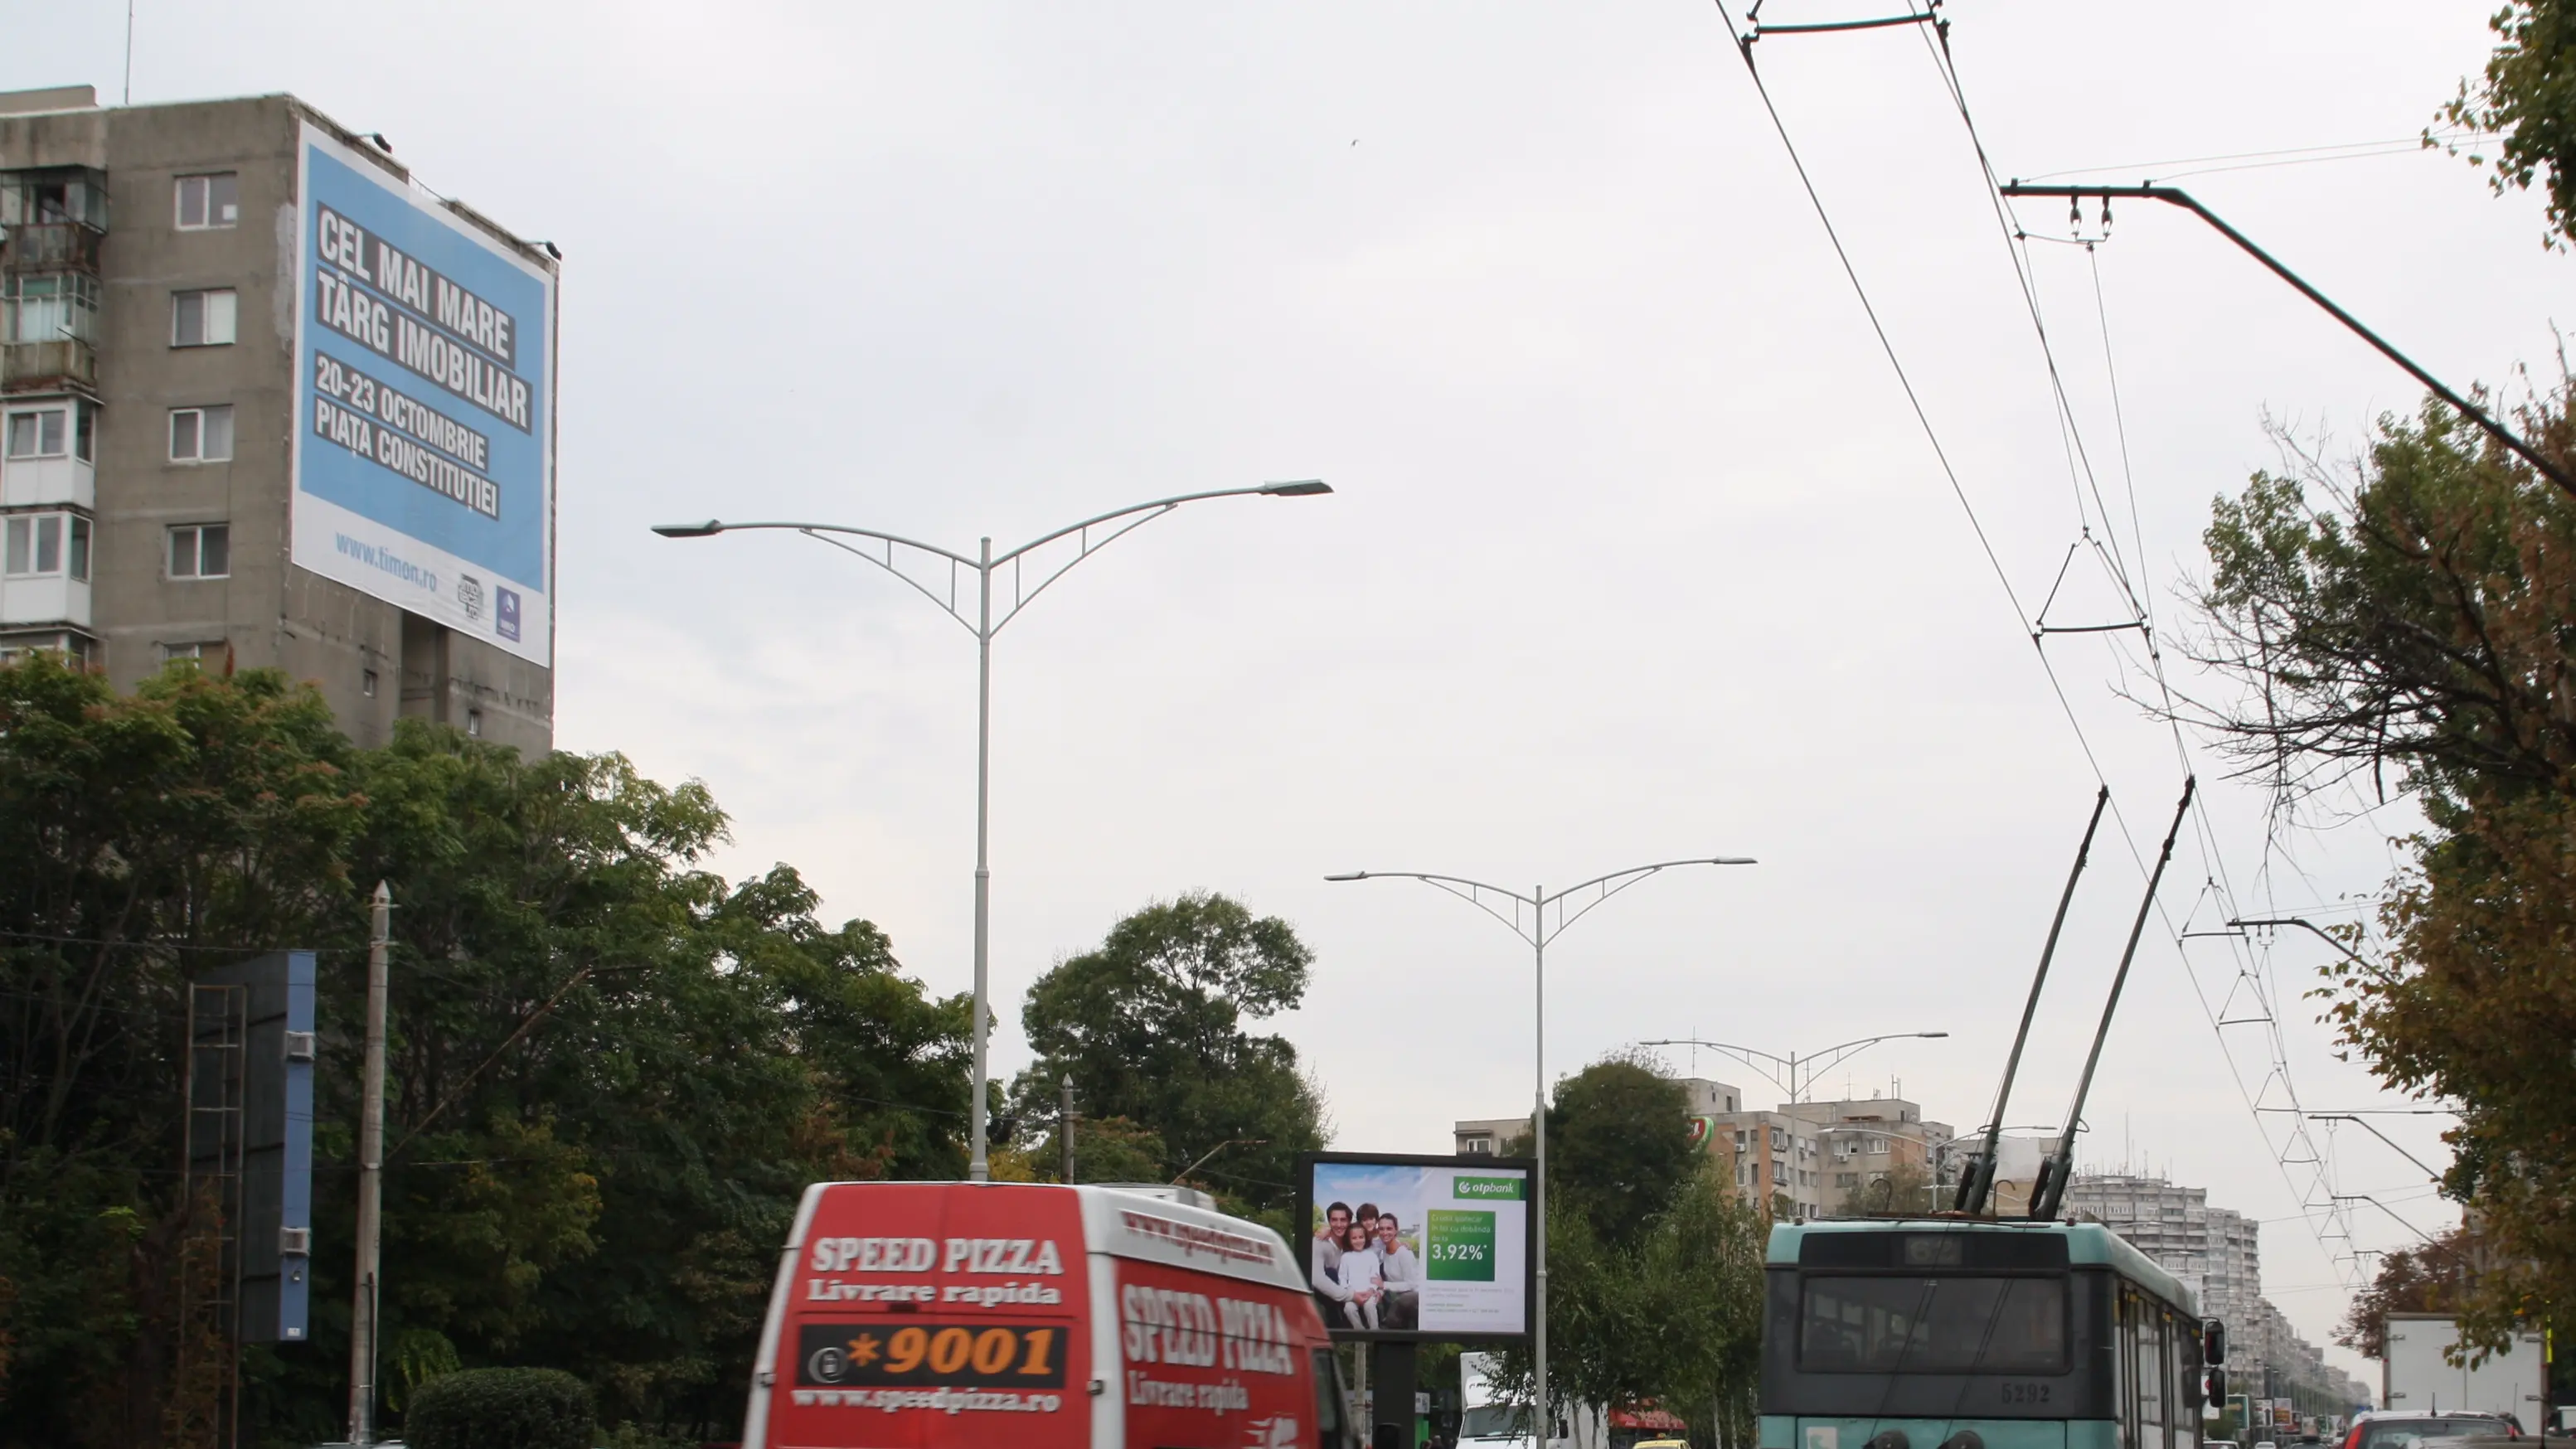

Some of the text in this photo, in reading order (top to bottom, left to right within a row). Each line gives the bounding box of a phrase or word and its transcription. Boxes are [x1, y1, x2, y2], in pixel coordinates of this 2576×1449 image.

[318, 210, 510, 360] CEL MAI MARE
[318, 269, 527, 429] TÂRG IMOBILIAR
[316, 356, 486, 470] 20-23 OCTOMBRIE
[335, 531, 438, 592] www.timon.ro
[812, 1238, 1064, 1275] SPEED PIZZA
[806, 1278, 1062, 1308] Livrare rapida
[1123, 1284, 1293, 1375] SPEED PIZZA
[791, 1387, 1062, 1415] www.speedpizza.ro
[1128, 1370, 1249, 1417] Livrare rapida
[2001, 1383, 2050, 1405] 5292
